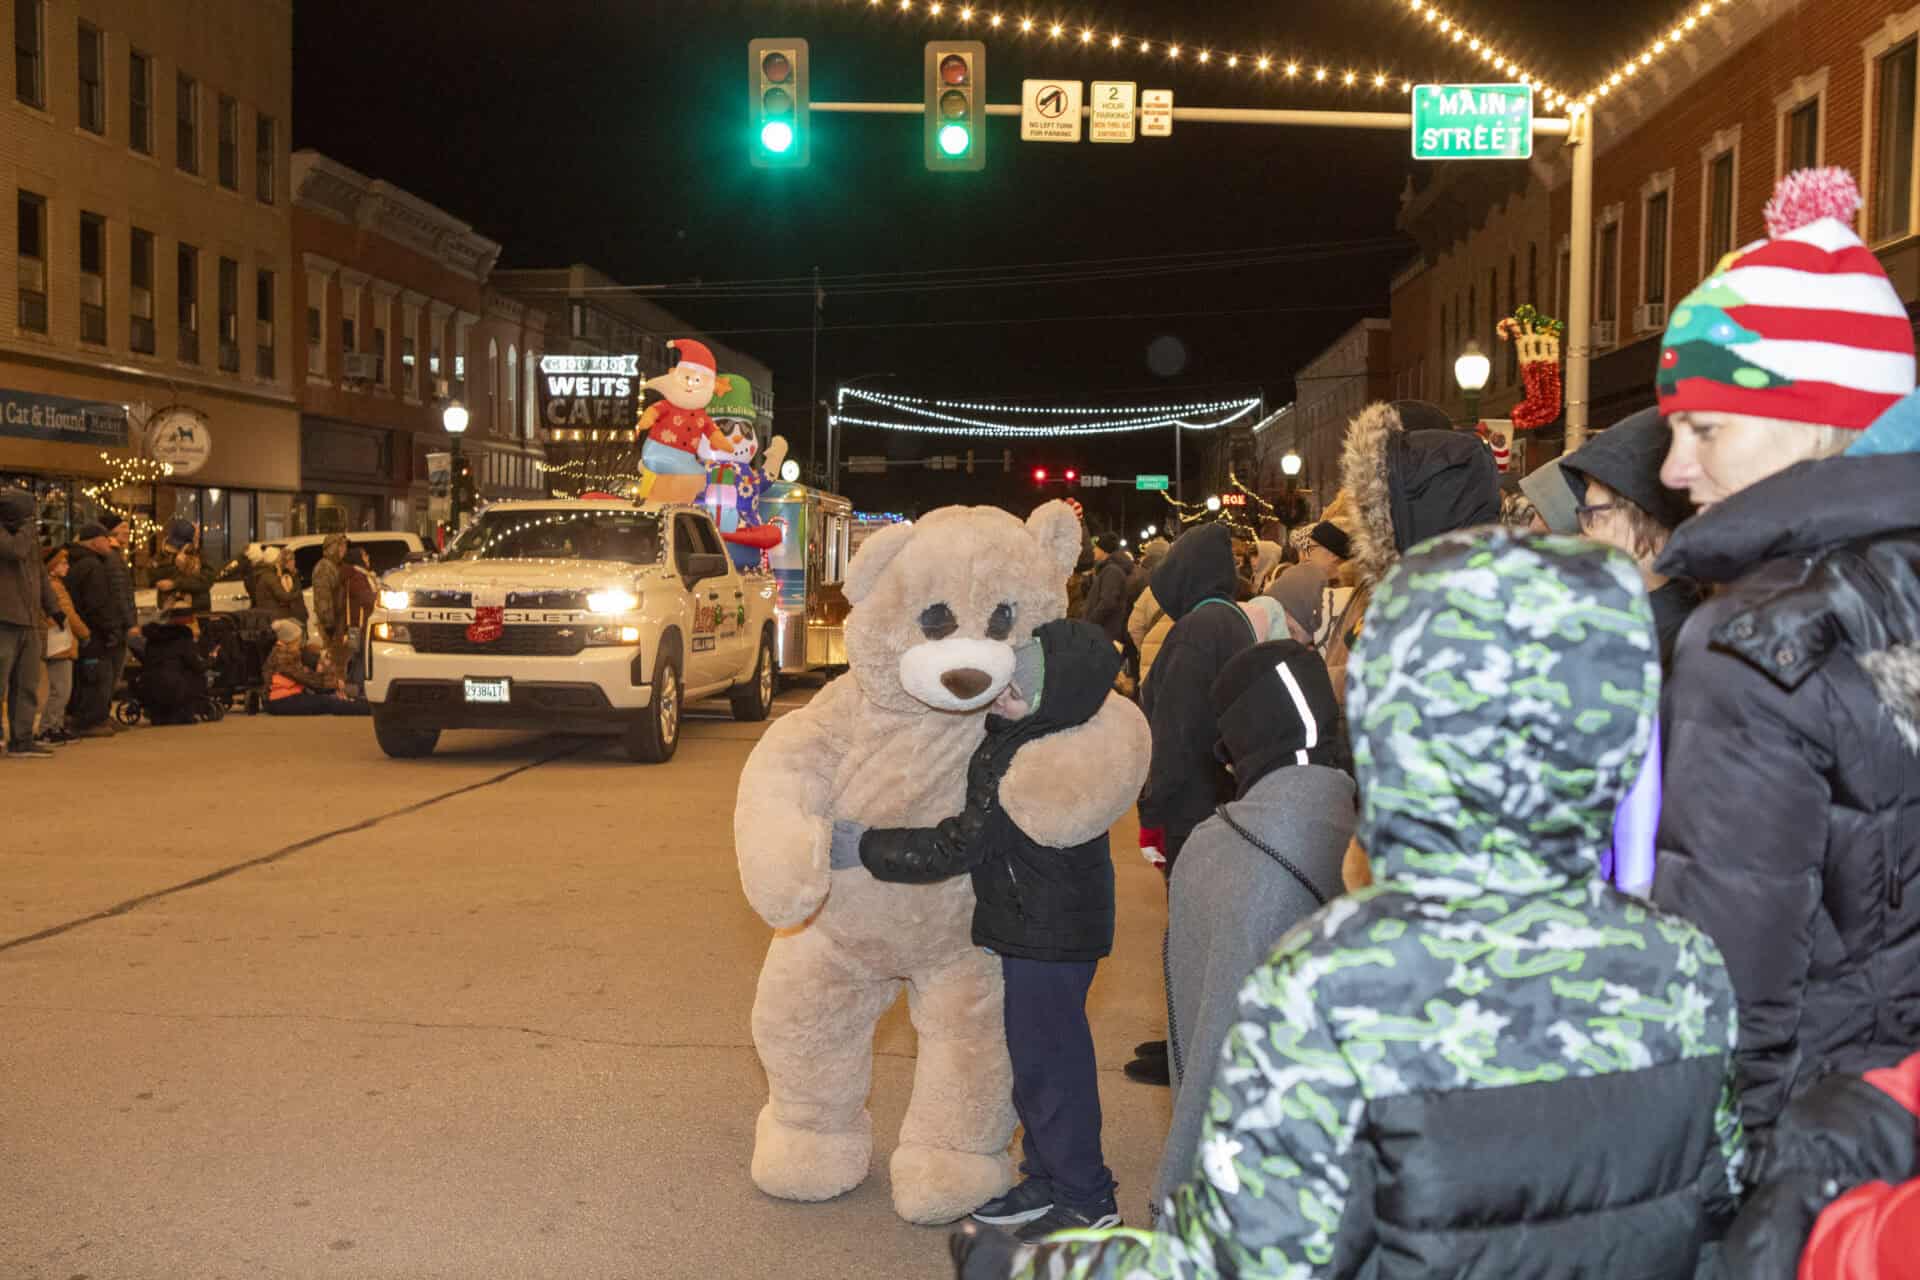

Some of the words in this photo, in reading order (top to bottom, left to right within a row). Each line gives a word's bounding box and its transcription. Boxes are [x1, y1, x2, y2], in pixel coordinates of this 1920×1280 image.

[1109, 87, 1119, 100] 2
[1439, 92, 1507, 115] MAIN
[1422, 127, 1522, 151] STREET
[547, 376, 631, 397] WEITS
[32, 405, 42, 426] &
[45, 406, 86, 432] Hound
[547, 398, 630, 425] CAFE
[411, 610, 581, 622] CHEVOLET
